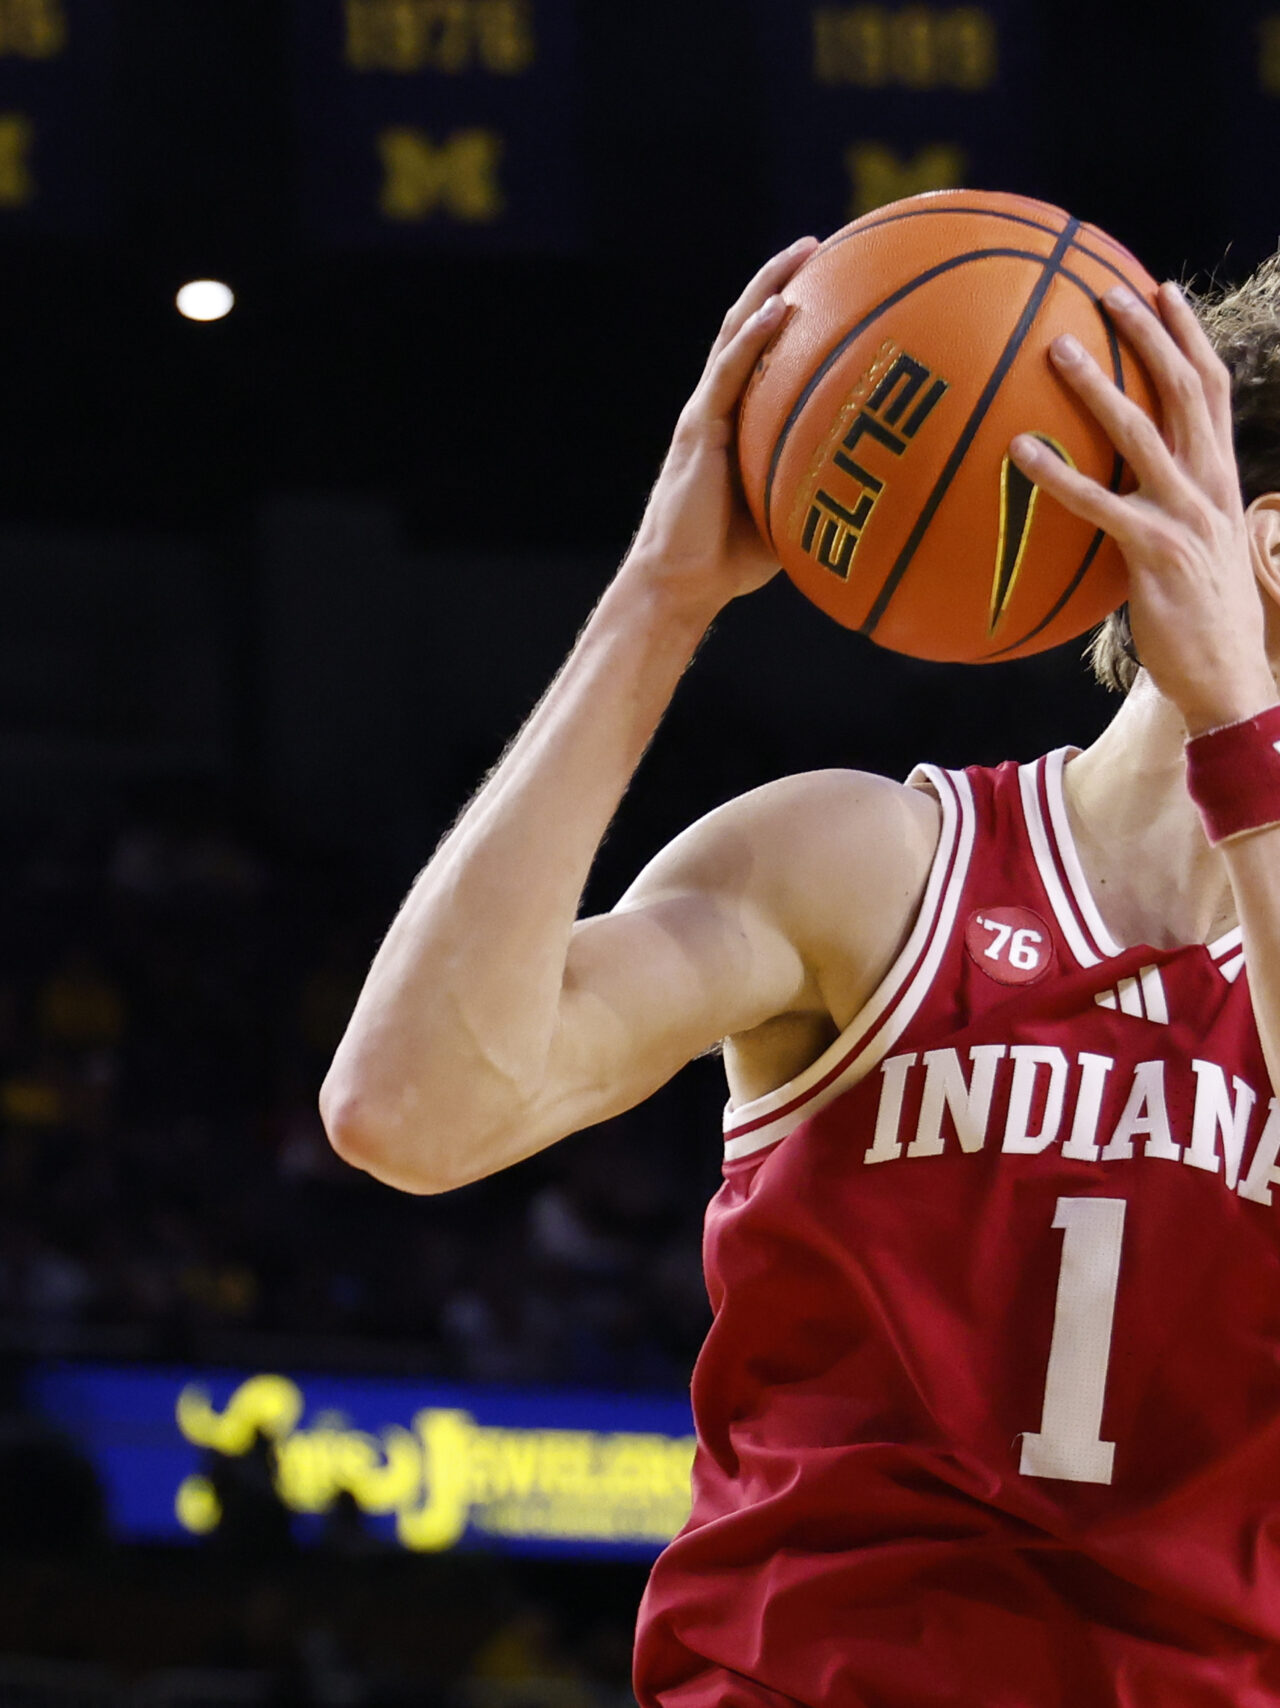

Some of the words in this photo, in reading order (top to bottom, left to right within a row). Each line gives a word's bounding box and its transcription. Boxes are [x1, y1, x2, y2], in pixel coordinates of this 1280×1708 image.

[377, 124, 505, 223] M
[801, 351, 949, 583] ELITE
[1018, 1196, 1127, 1485] 1
